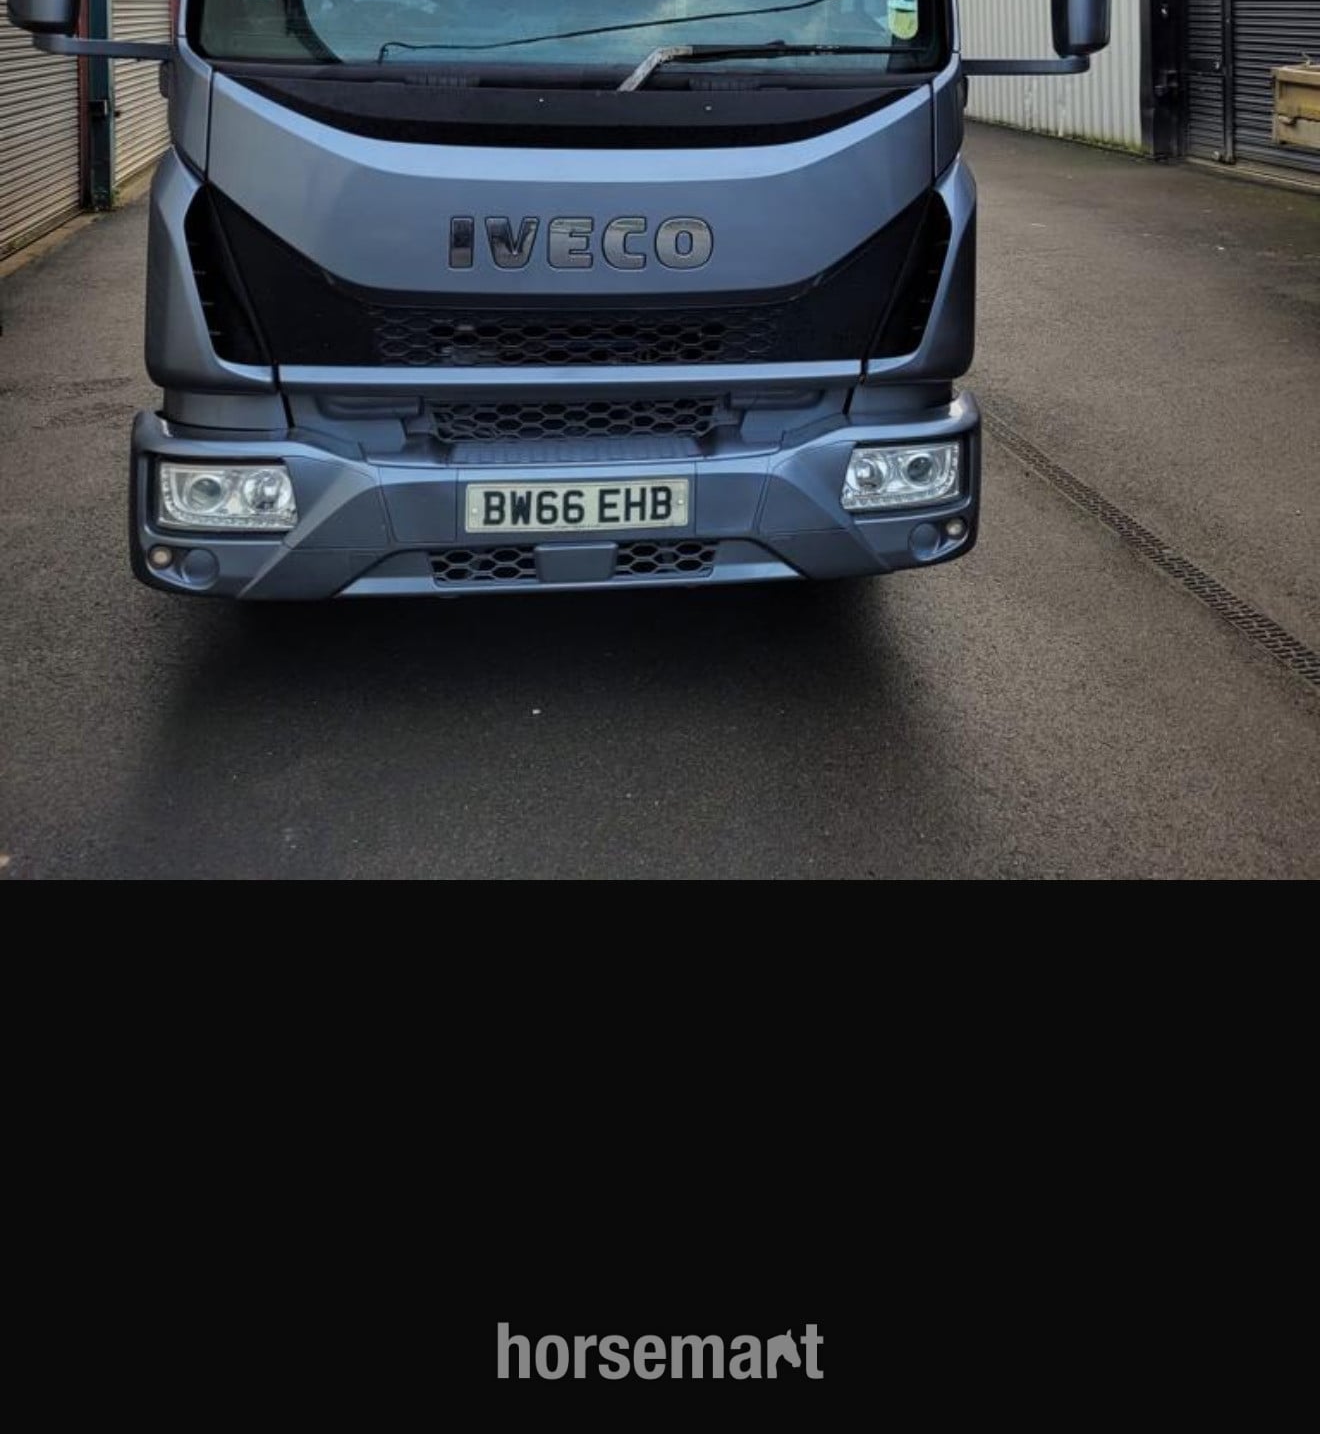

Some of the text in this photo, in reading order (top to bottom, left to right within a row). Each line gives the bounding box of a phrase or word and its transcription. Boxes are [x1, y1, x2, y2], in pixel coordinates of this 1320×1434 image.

[449, 216, 714, 269] IVECO
[483, 485, 673, 526] BW66 EHB
